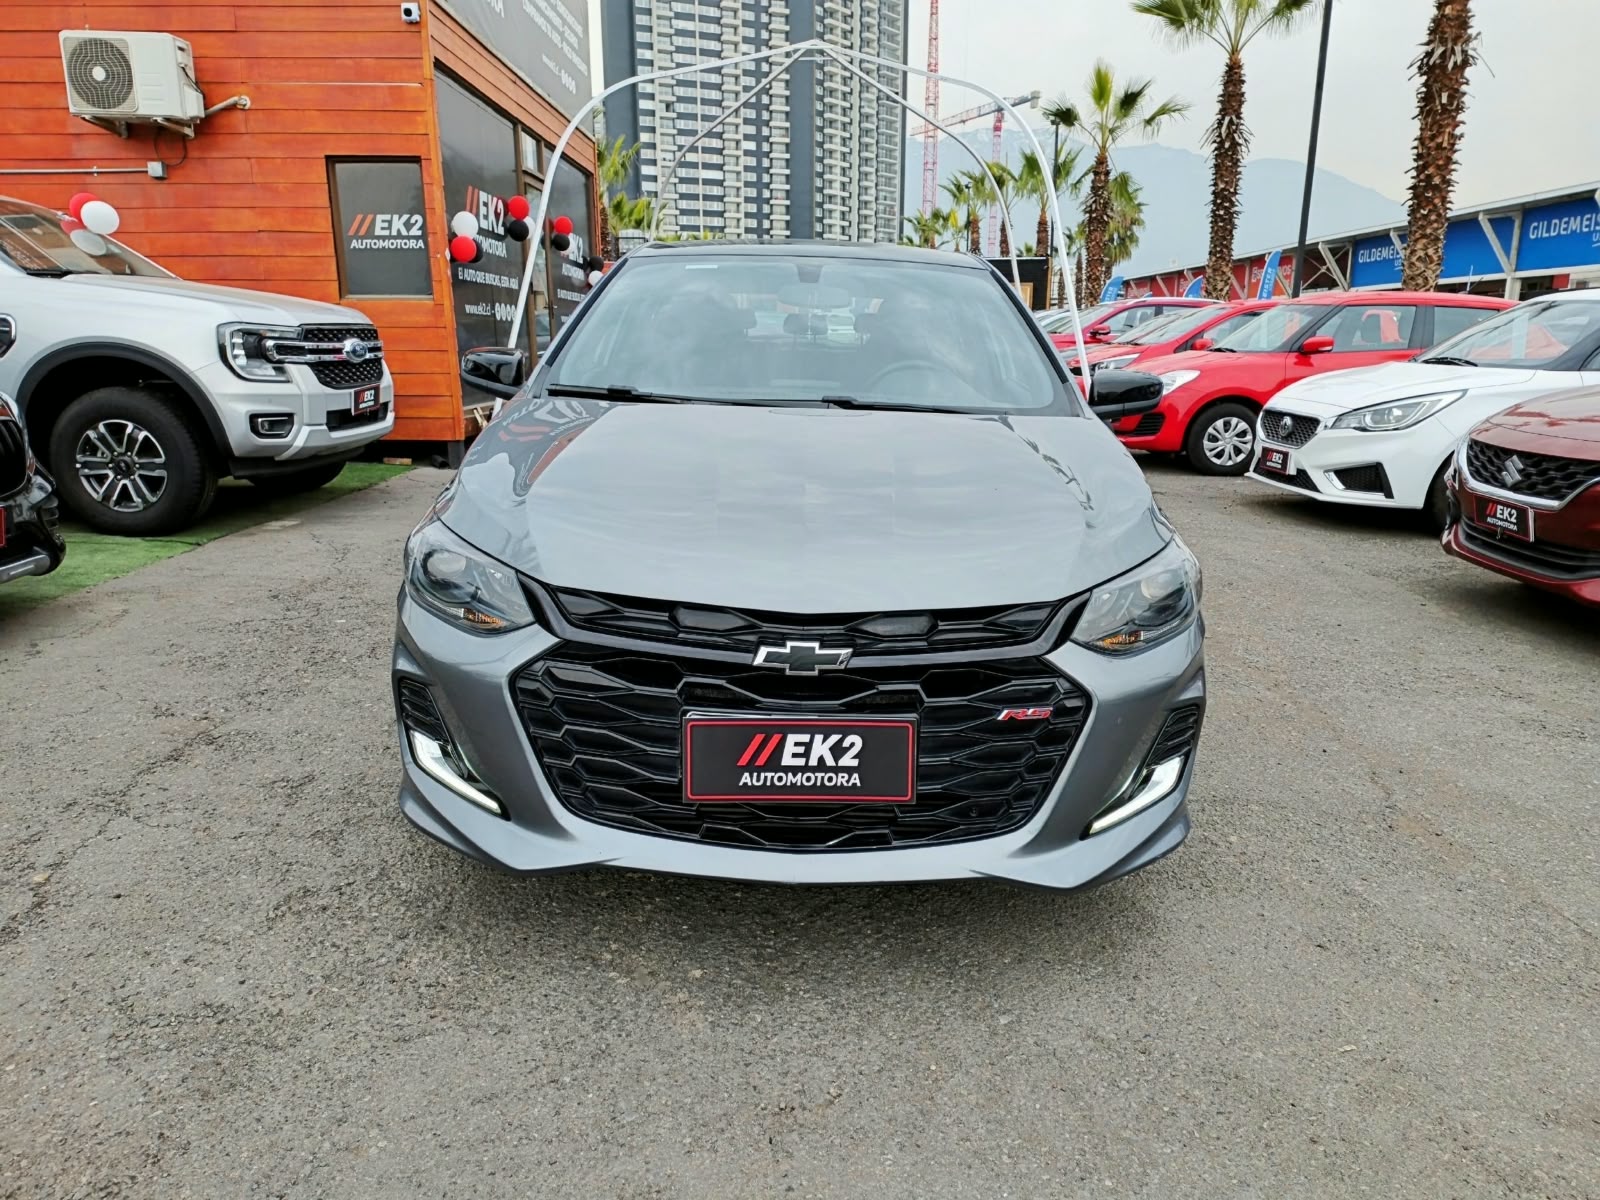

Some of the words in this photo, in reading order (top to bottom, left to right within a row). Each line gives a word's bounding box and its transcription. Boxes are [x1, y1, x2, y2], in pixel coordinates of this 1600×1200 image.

[479, 190, 505, 235] EK2
[374, 214, 423, 236] EK2
[350, 239, 425, 249] AUTOMOTORA
[464, 268, 476, 282] AUTO
[476, 270, 486, 284] QUE
[1497, 505, 1517, 523] EK2
[1487, 516, 1518, 532] AUTOMOTORA
[997, 707, 1053, 720] RS
[781, 733, 863, 767] EK2
[739, 772, 861, 787] AUTOMOTORA
